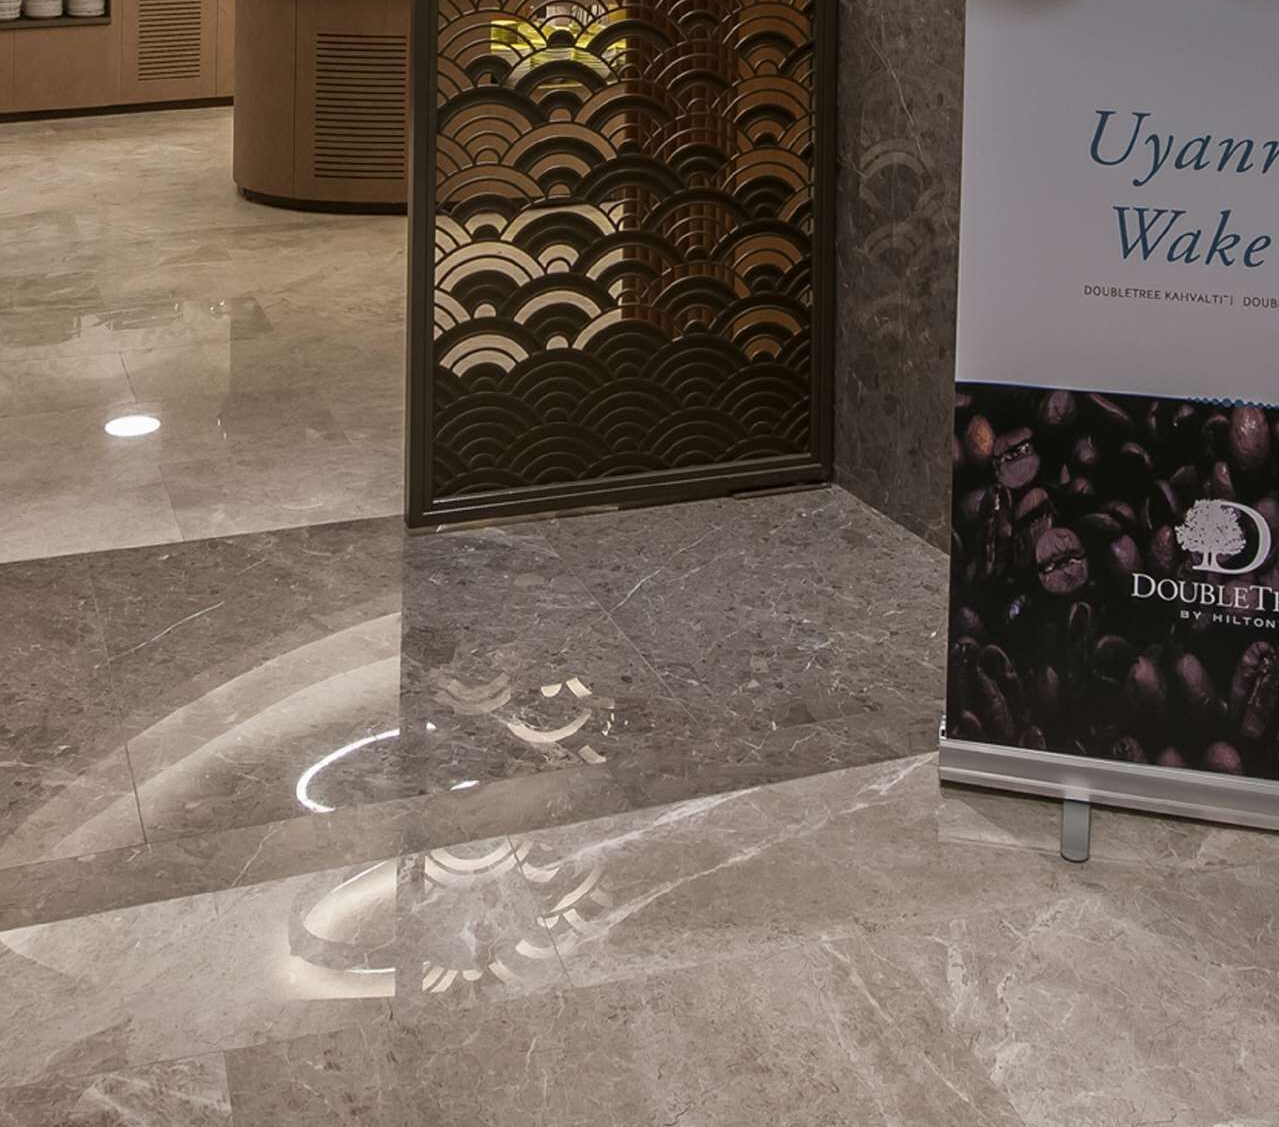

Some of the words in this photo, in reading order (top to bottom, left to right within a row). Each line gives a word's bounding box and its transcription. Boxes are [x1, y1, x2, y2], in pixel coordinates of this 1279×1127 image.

[1113, 206, 1272, 268] Wake
[1084, 285, 1161, 301] DOUBLETREE
[1180, 610, 1202, 621] BY
[1212, 613, 1276, 629] HILTON
